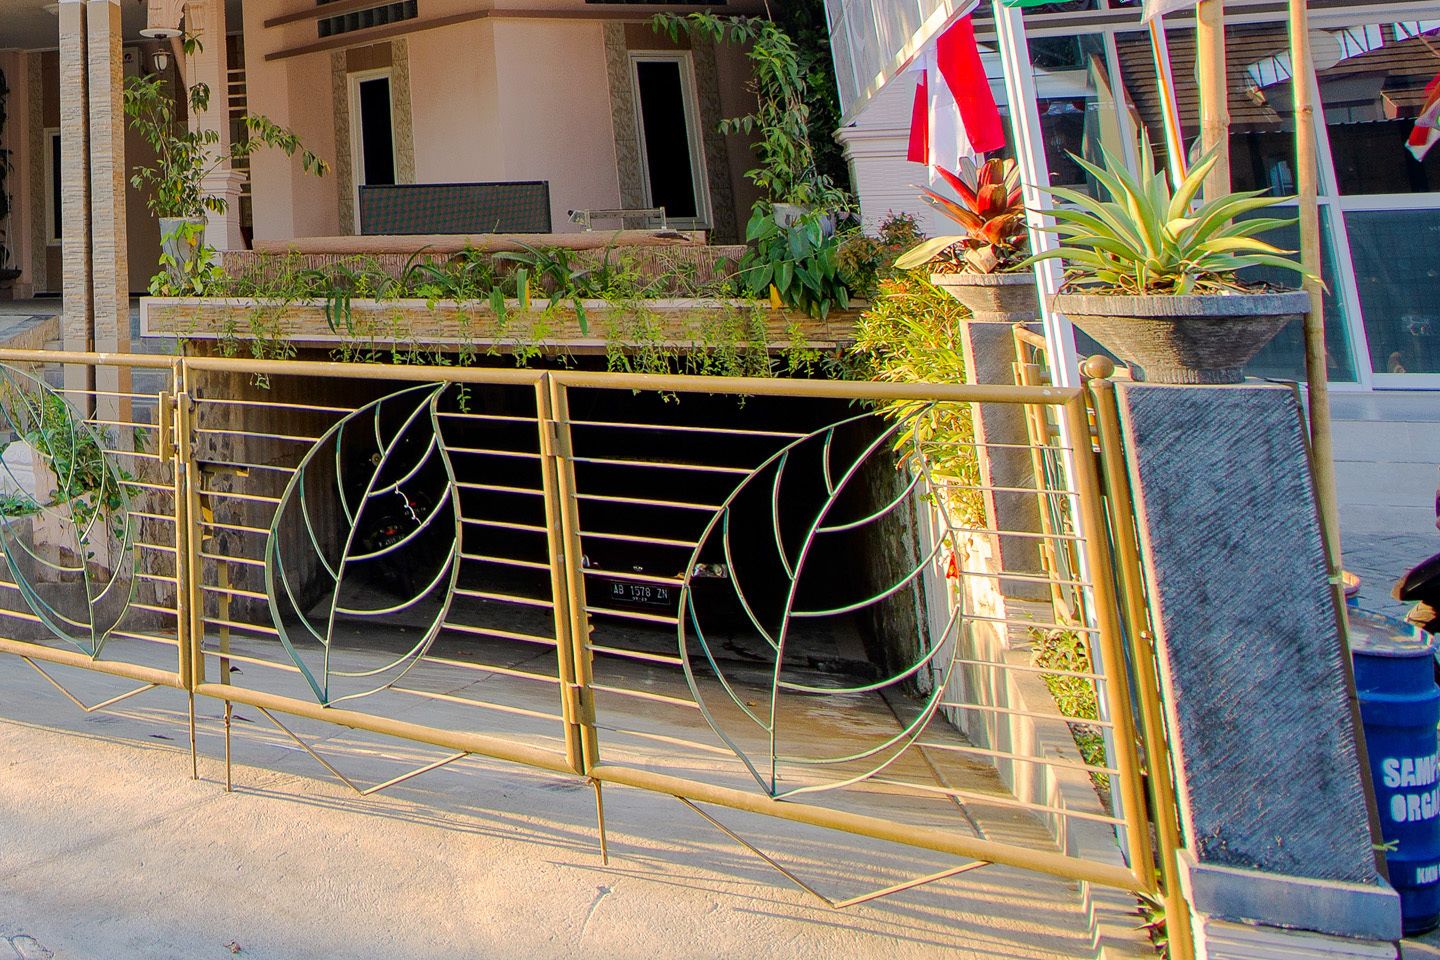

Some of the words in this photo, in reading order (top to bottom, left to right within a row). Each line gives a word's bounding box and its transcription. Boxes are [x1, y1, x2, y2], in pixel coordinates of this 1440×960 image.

[613, 584, 624, 595] AB
[630, 586, 651, 597] 1578
[656, 588, 668, 599] ZN
